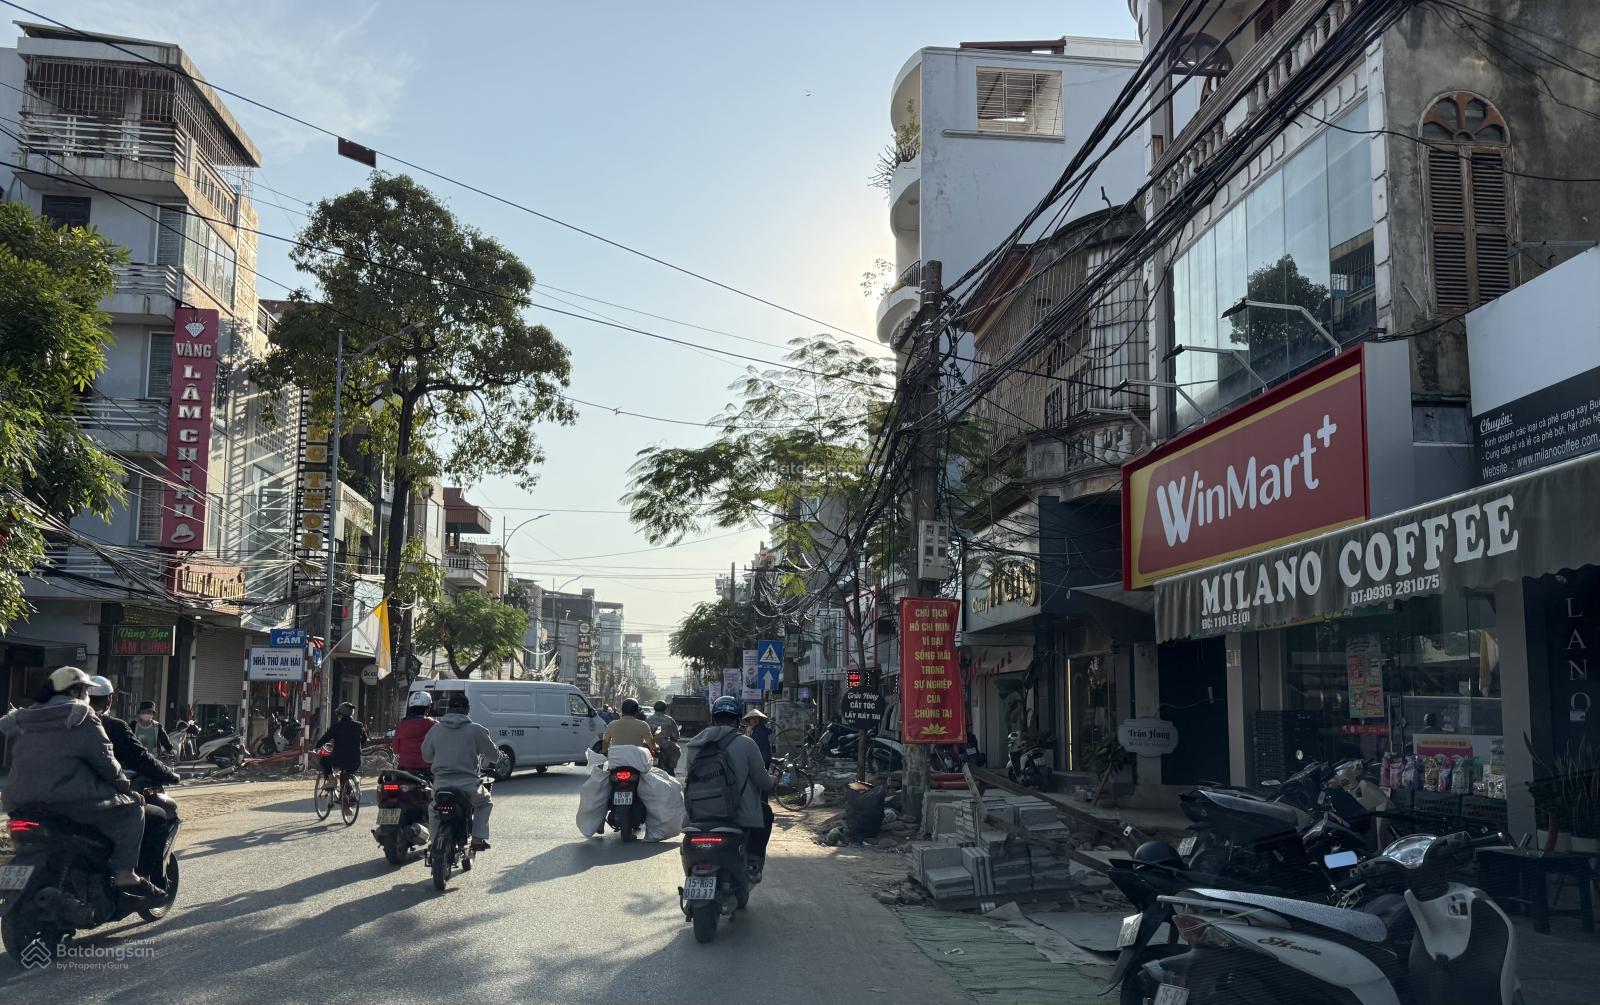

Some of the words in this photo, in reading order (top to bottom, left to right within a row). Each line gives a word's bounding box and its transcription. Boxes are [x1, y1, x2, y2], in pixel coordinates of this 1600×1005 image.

[175, 340, 212, 357] VÀNG
[1482, 462, 1508, 479] Website
[1201, 551, 1321, 615] MILANO
[1339, 495, 1518, 588] COFFEE
[1395, 574, 1440, 596] 281075
[1228, 611, 1238, 625] LÊ
[253, 655, 266, 666] NHÀ
[267, 655, 279, 666] THỜ
[280, 657, 289, 666] AN
[290, 655, 301, 666] HẢI
[922, 665, 945, 675] TRONG
[926, 679, 953, 690] NGHIỆP
